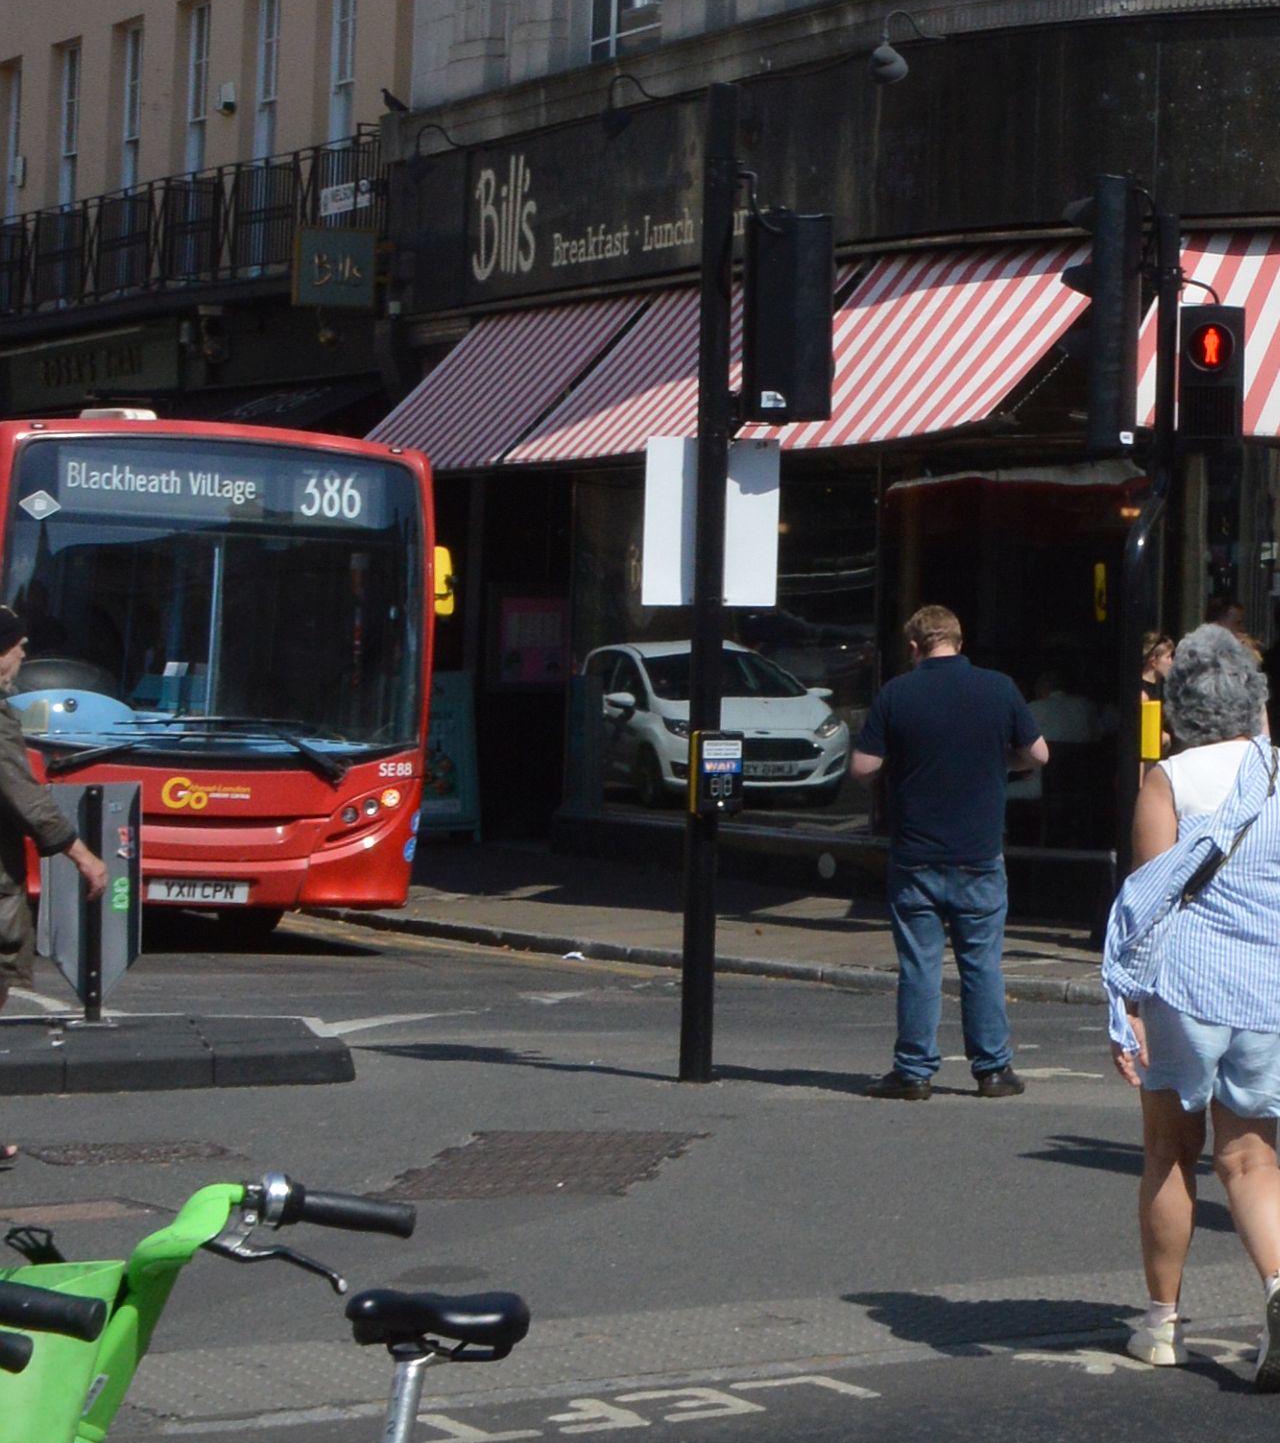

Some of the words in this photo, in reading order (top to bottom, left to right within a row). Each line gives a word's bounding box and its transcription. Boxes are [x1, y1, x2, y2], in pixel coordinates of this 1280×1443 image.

[472, 154, 537, 282] Bill's
[552, 222, 630, 267] Breakfast
[641, 208, 694, 252] Lunch
[66, 462, 181, 494] Blackheath
[189, 470, 256, 505] Village
[300, 473, 361, 519] 386
[378, 762, 412, 777] SE88
[162, 776, 208, 810] Go
[201, 882, 236, 899] CPN
